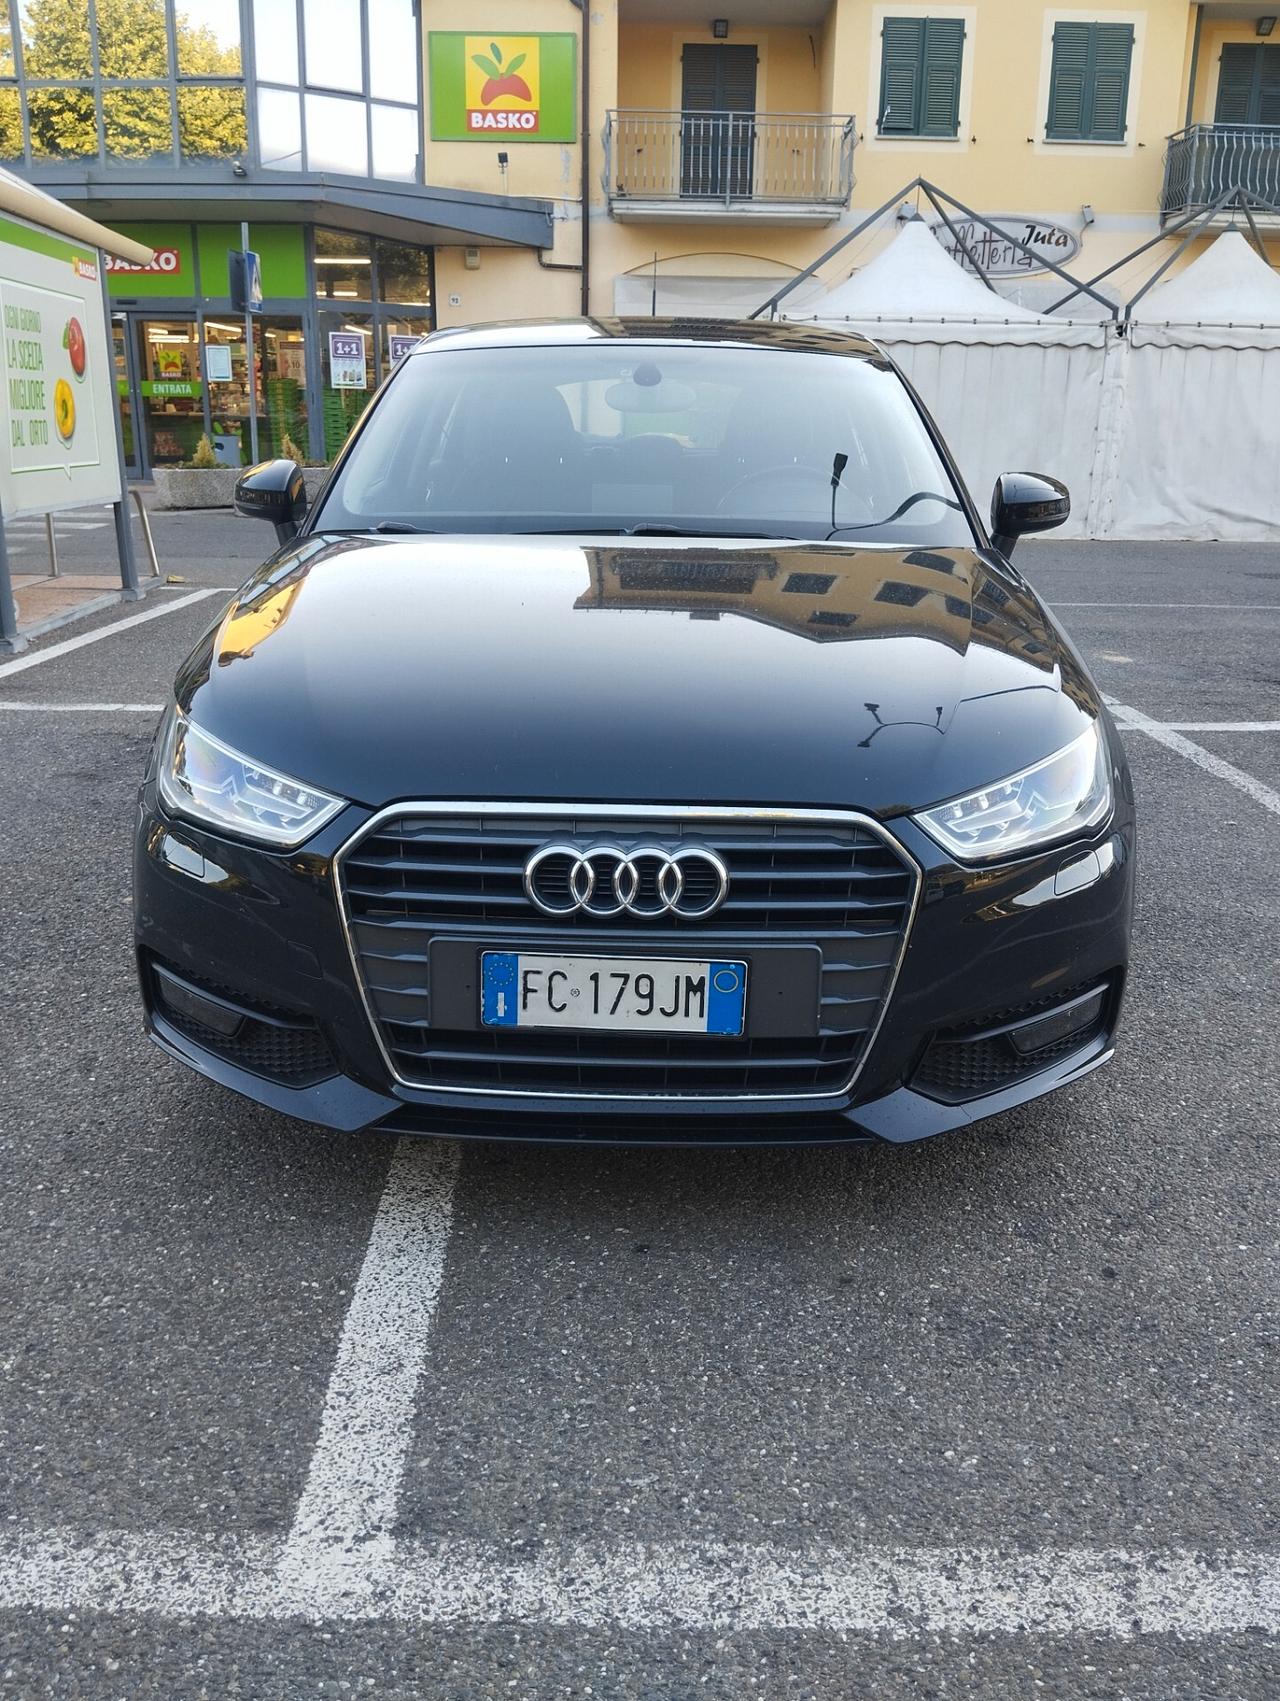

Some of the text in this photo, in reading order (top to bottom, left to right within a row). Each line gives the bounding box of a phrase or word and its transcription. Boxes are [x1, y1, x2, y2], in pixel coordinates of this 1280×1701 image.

[471, 112, 535, 129] BASKO
[1022, 224, 1069, 248] Juta
[6, 337, 43, 371] LA SCELTA
[336, 342, 358, 355] 1+1
[9, 378, 46, 410] MIGLIORE
[152, 384, 192, 394] ENTRATA
[30, 419, 48, 445] ORTO
[522, 970, 706, 1018] FC 179JM
